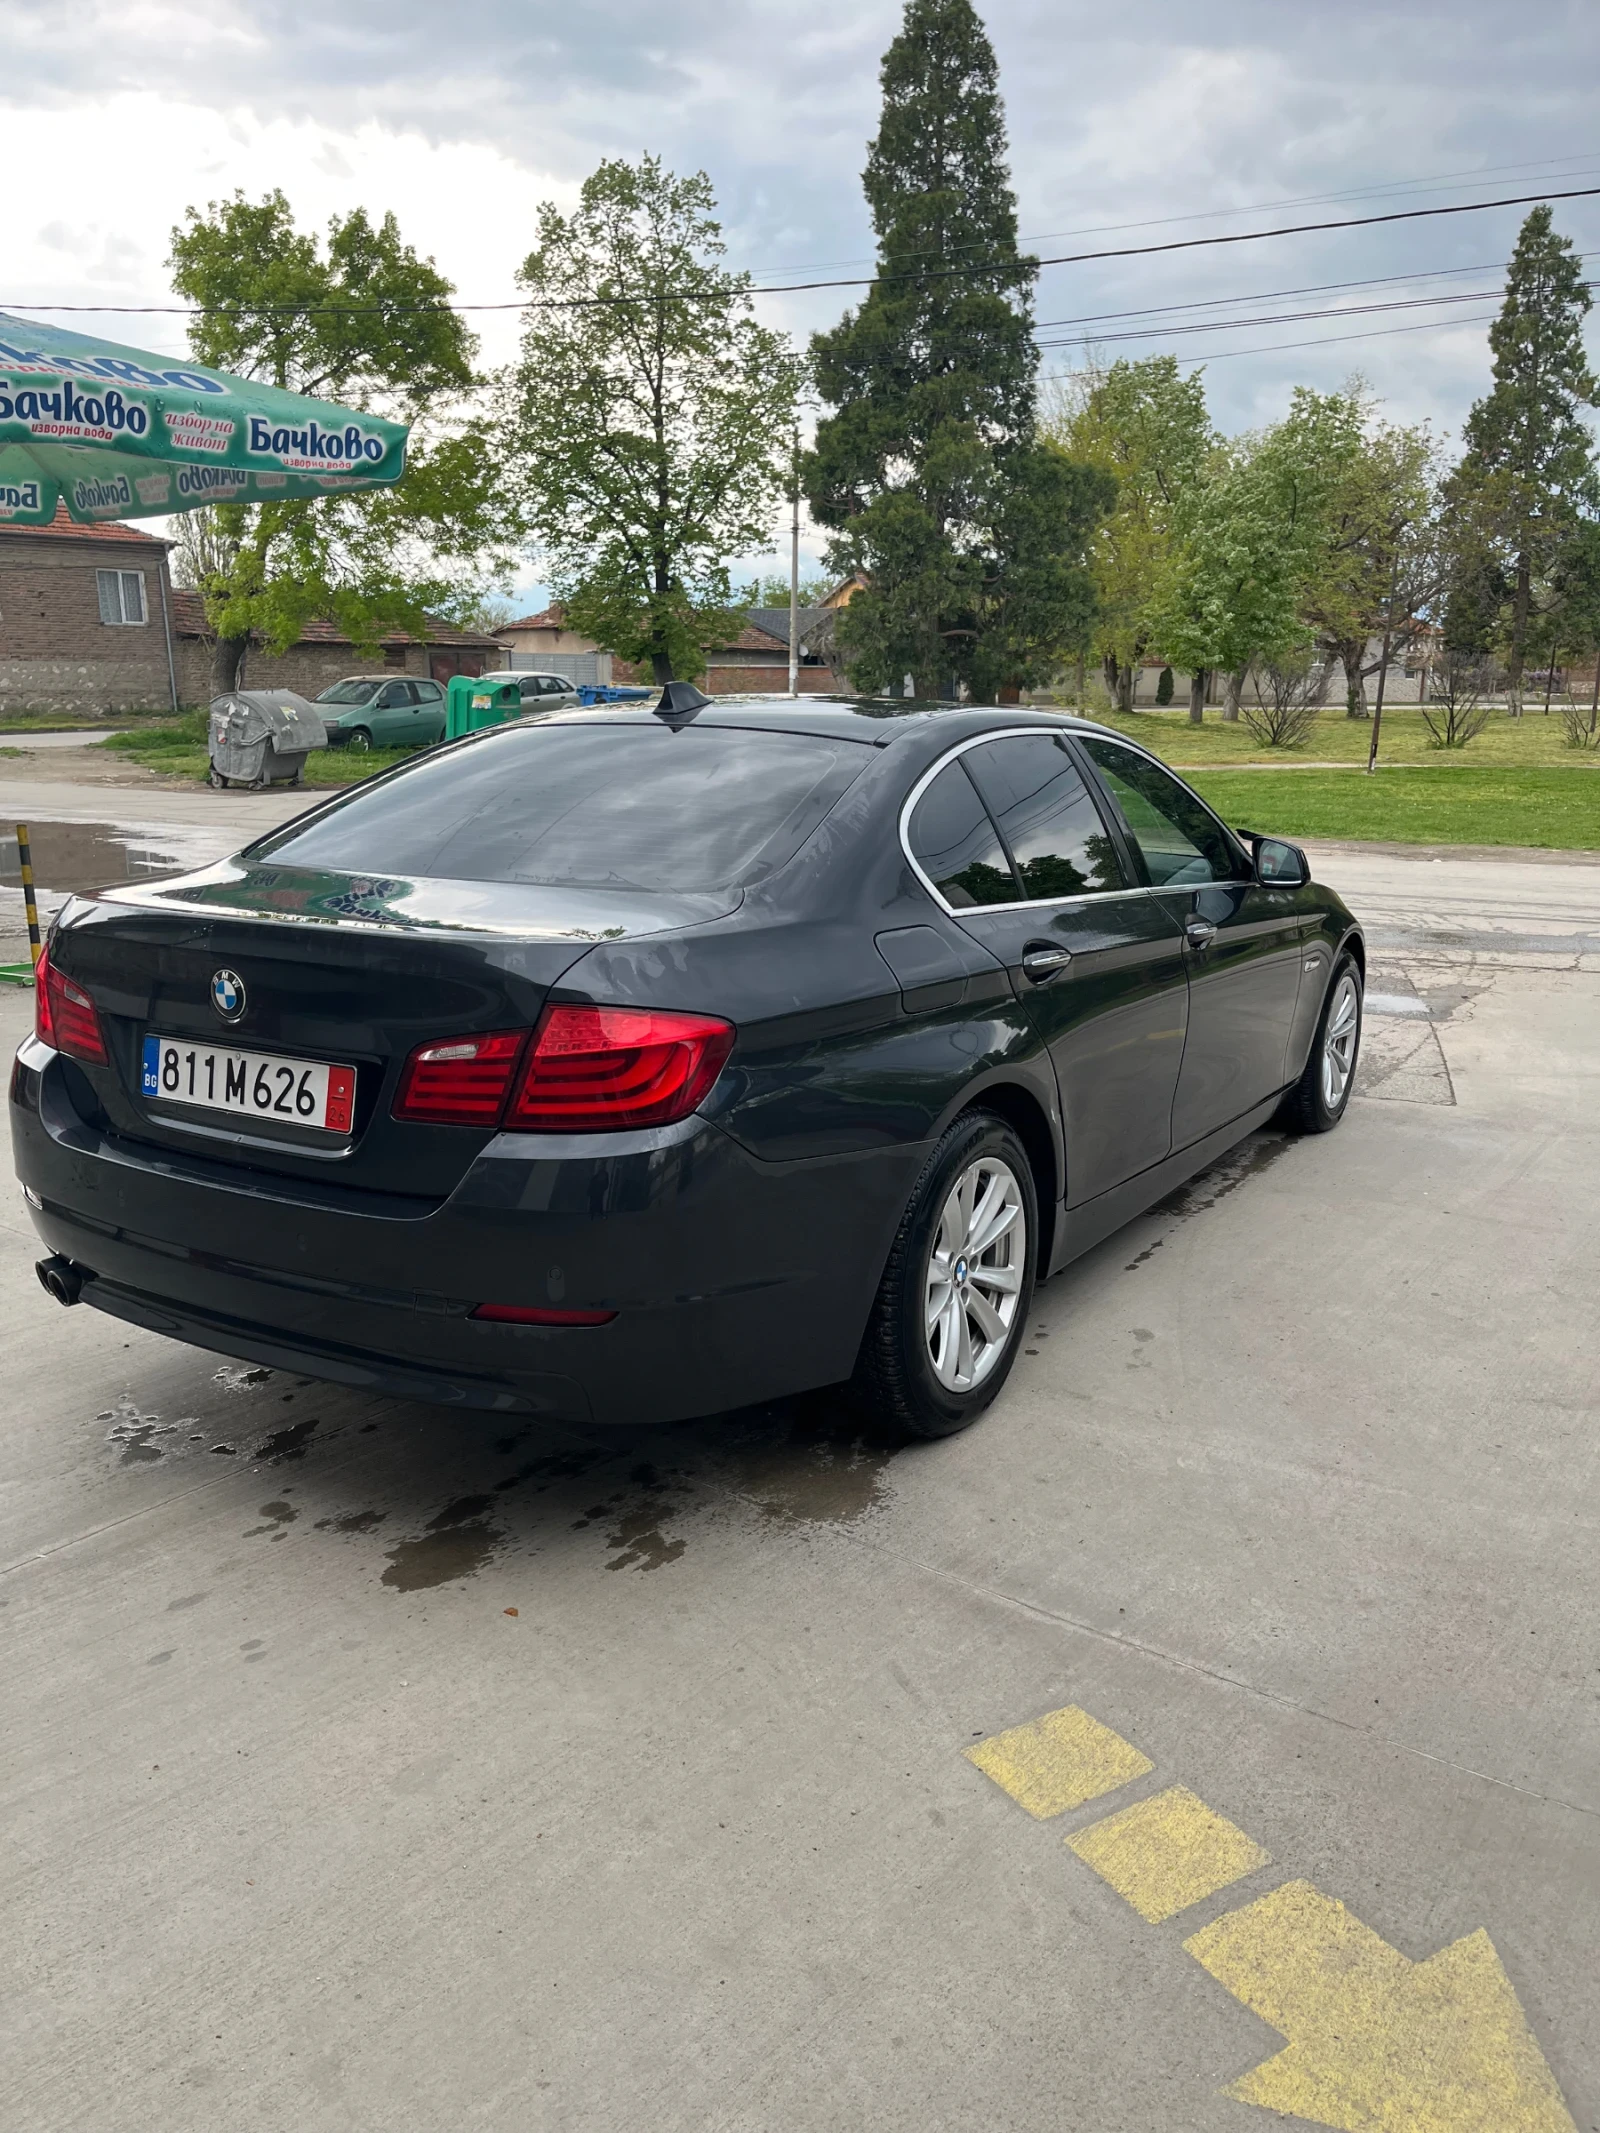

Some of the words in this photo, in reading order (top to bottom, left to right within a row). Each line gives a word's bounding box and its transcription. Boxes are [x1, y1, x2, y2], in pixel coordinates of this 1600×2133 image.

[0, 342, 225, 394] ково
[31, 423, 80, 437] изворна
[84, 428, 113, 440] вода
[165, 412, 211, 434] избор
[214, 420, 234, 434] на
[171, 433, 227, 450] живот
[250, 418, 383, 460] Бачково
[282, 458, 324, 470] изворна
[326, 460, 351, 469] вода
[144, 1073, 157, 1088] BG
[162, 1048, 316, 1116] 811M626
[329, 1106, 345, 1123] 26
